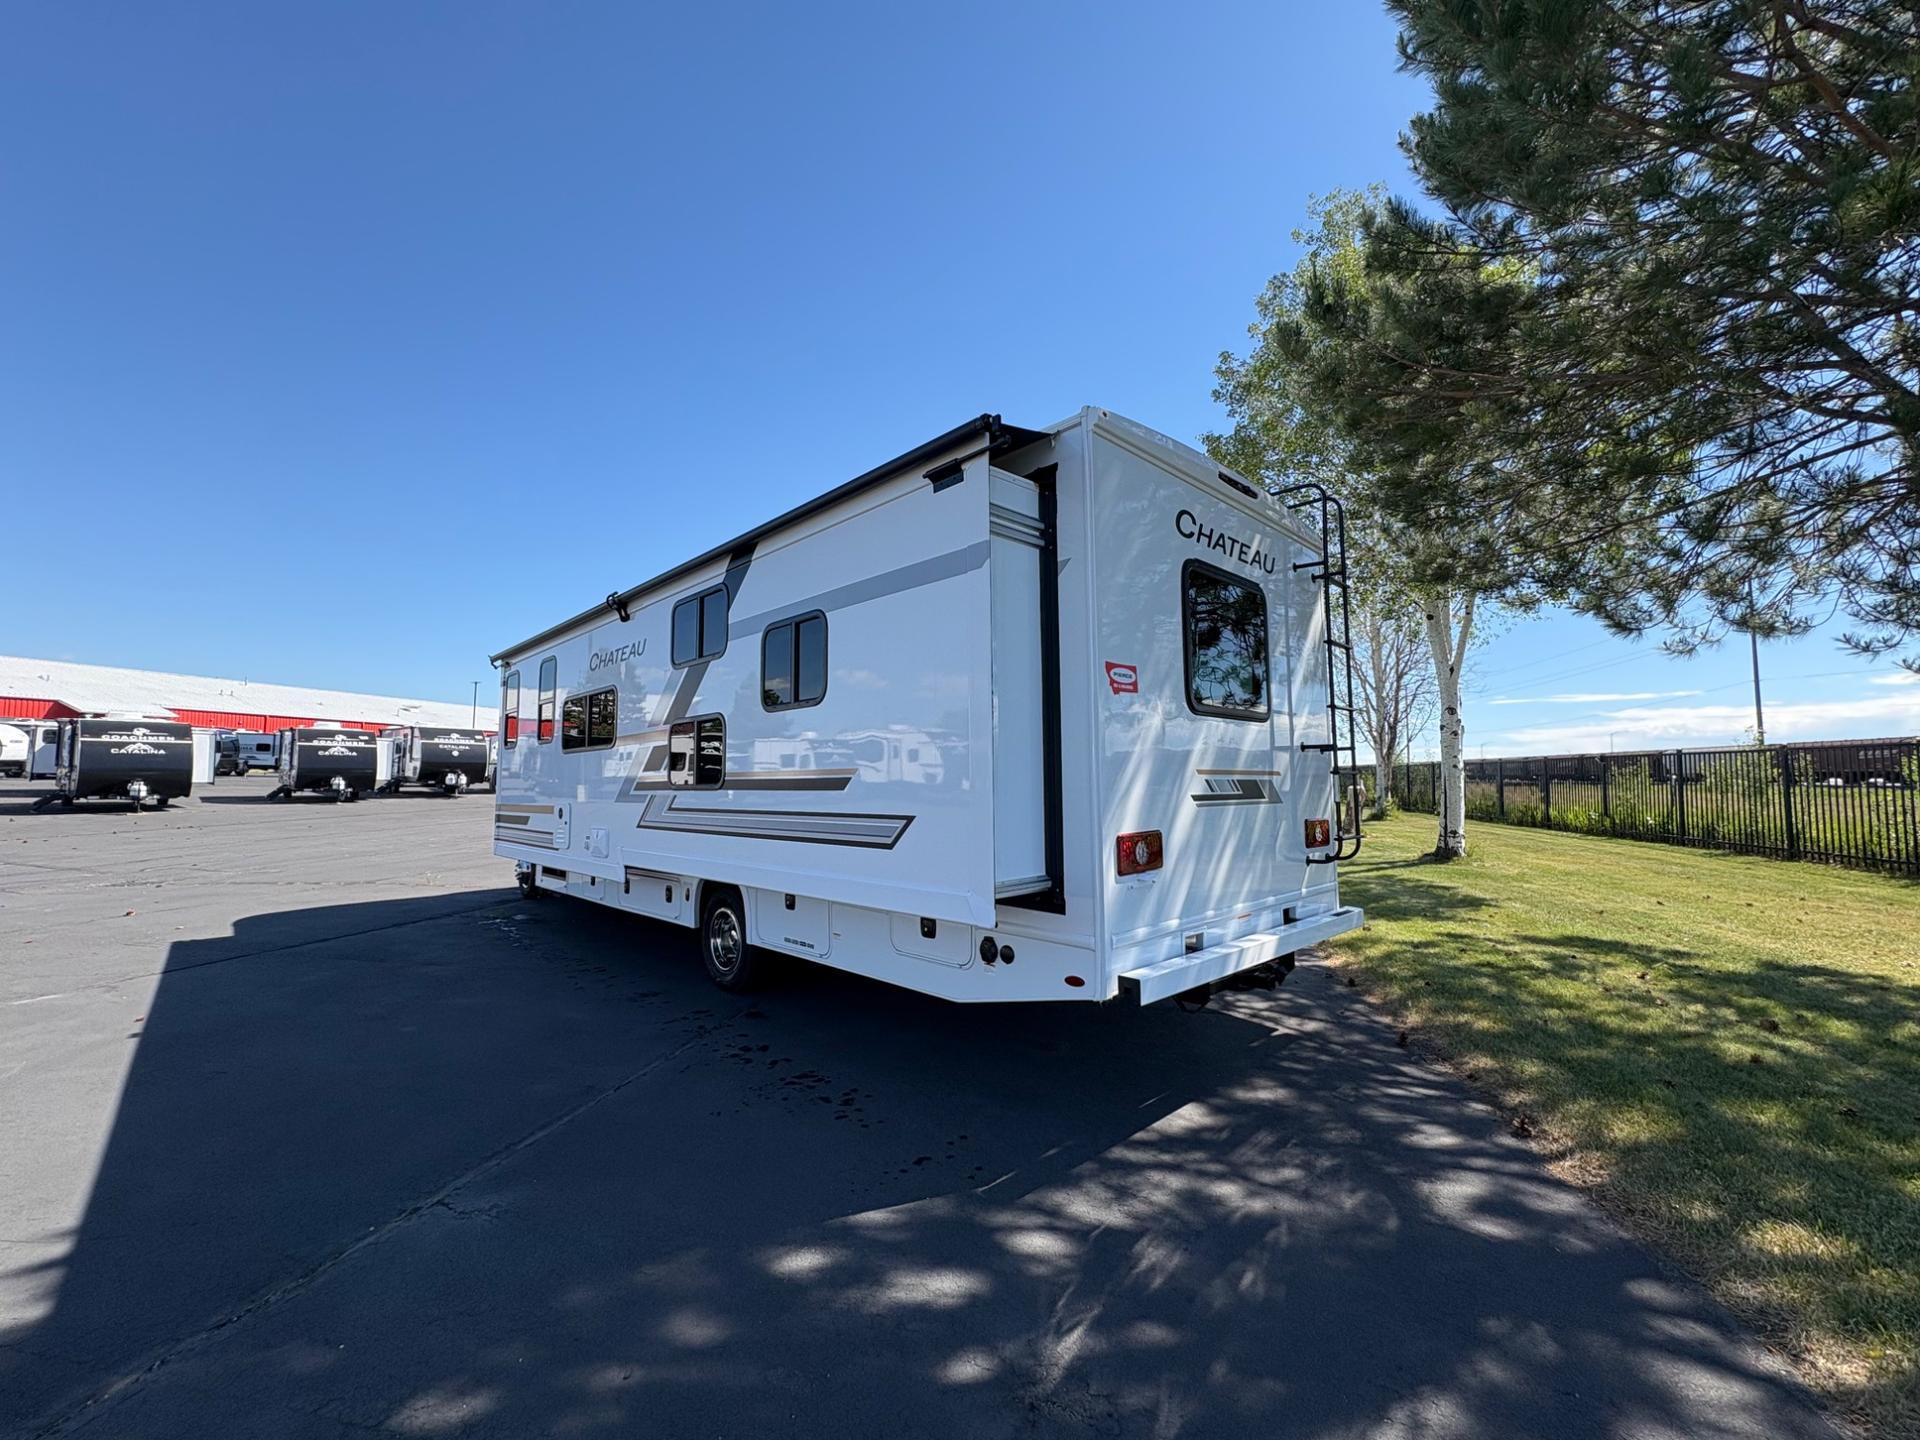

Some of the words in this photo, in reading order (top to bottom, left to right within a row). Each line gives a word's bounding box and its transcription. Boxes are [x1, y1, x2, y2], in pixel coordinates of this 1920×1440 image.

[1175, 509, 1276, 574] CHATEAU
[589, 638, 648, 672] CHATEAU
[101, 734, 175, 742] COACHMEN
[110, 747, 166, 755] CATALINA
